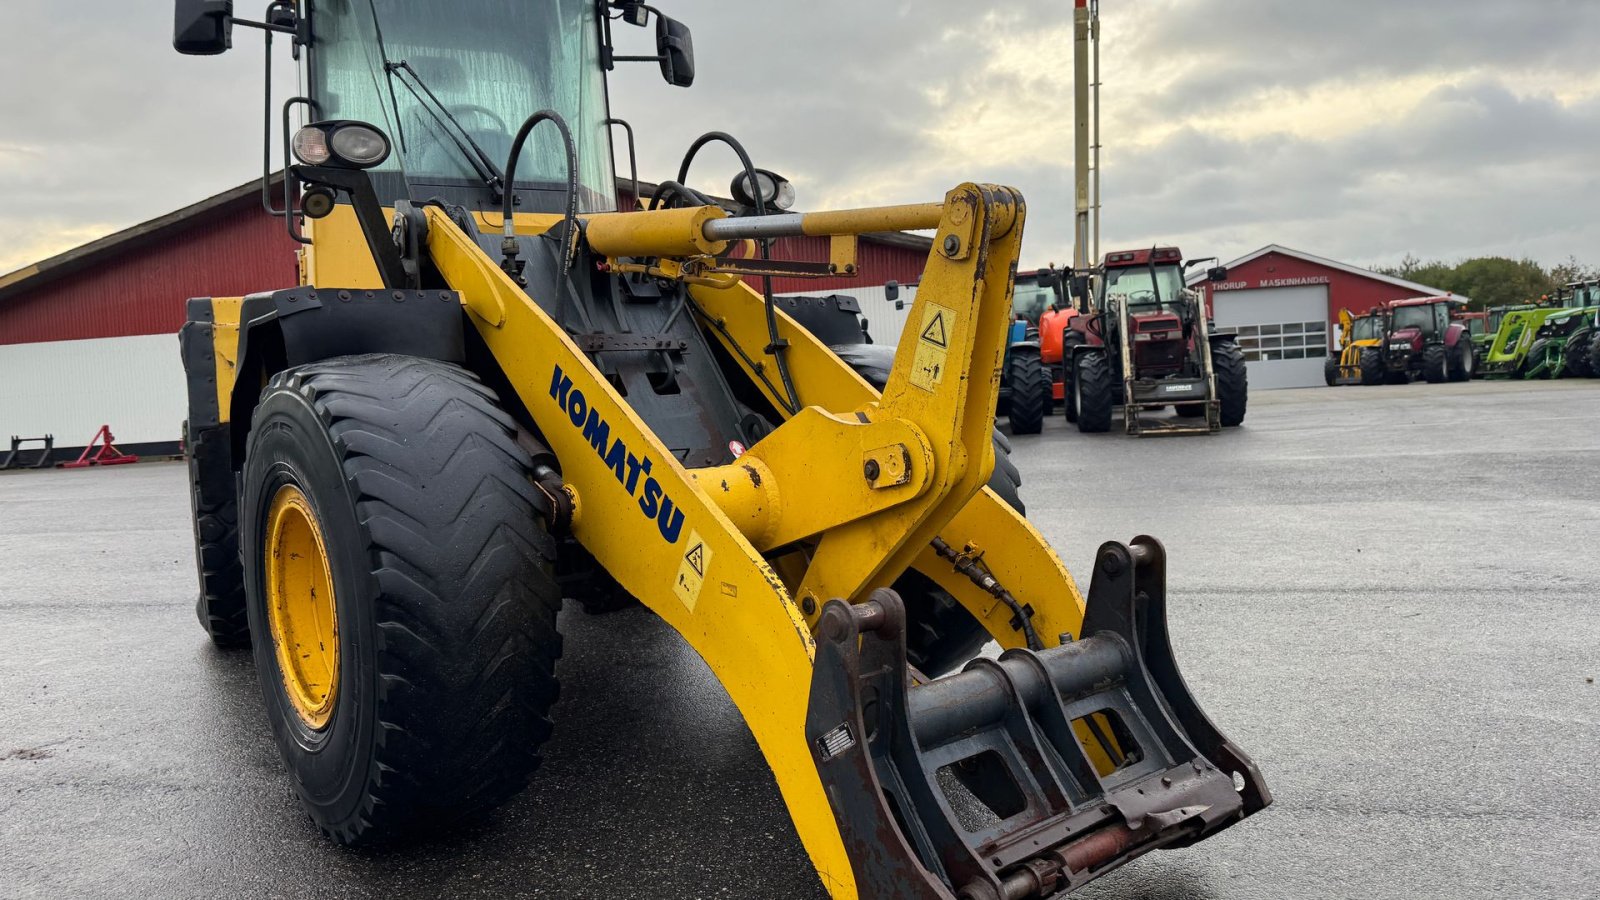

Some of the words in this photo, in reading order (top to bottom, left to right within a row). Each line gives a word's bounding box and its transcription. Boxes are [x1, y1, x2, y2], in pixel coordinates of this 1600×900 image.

[1212, 281, 1248, 291] THORUP
[1260, 276, 1330, 288] MASKINHANDEL
[549, 364, 685, 544] KOMATSU
